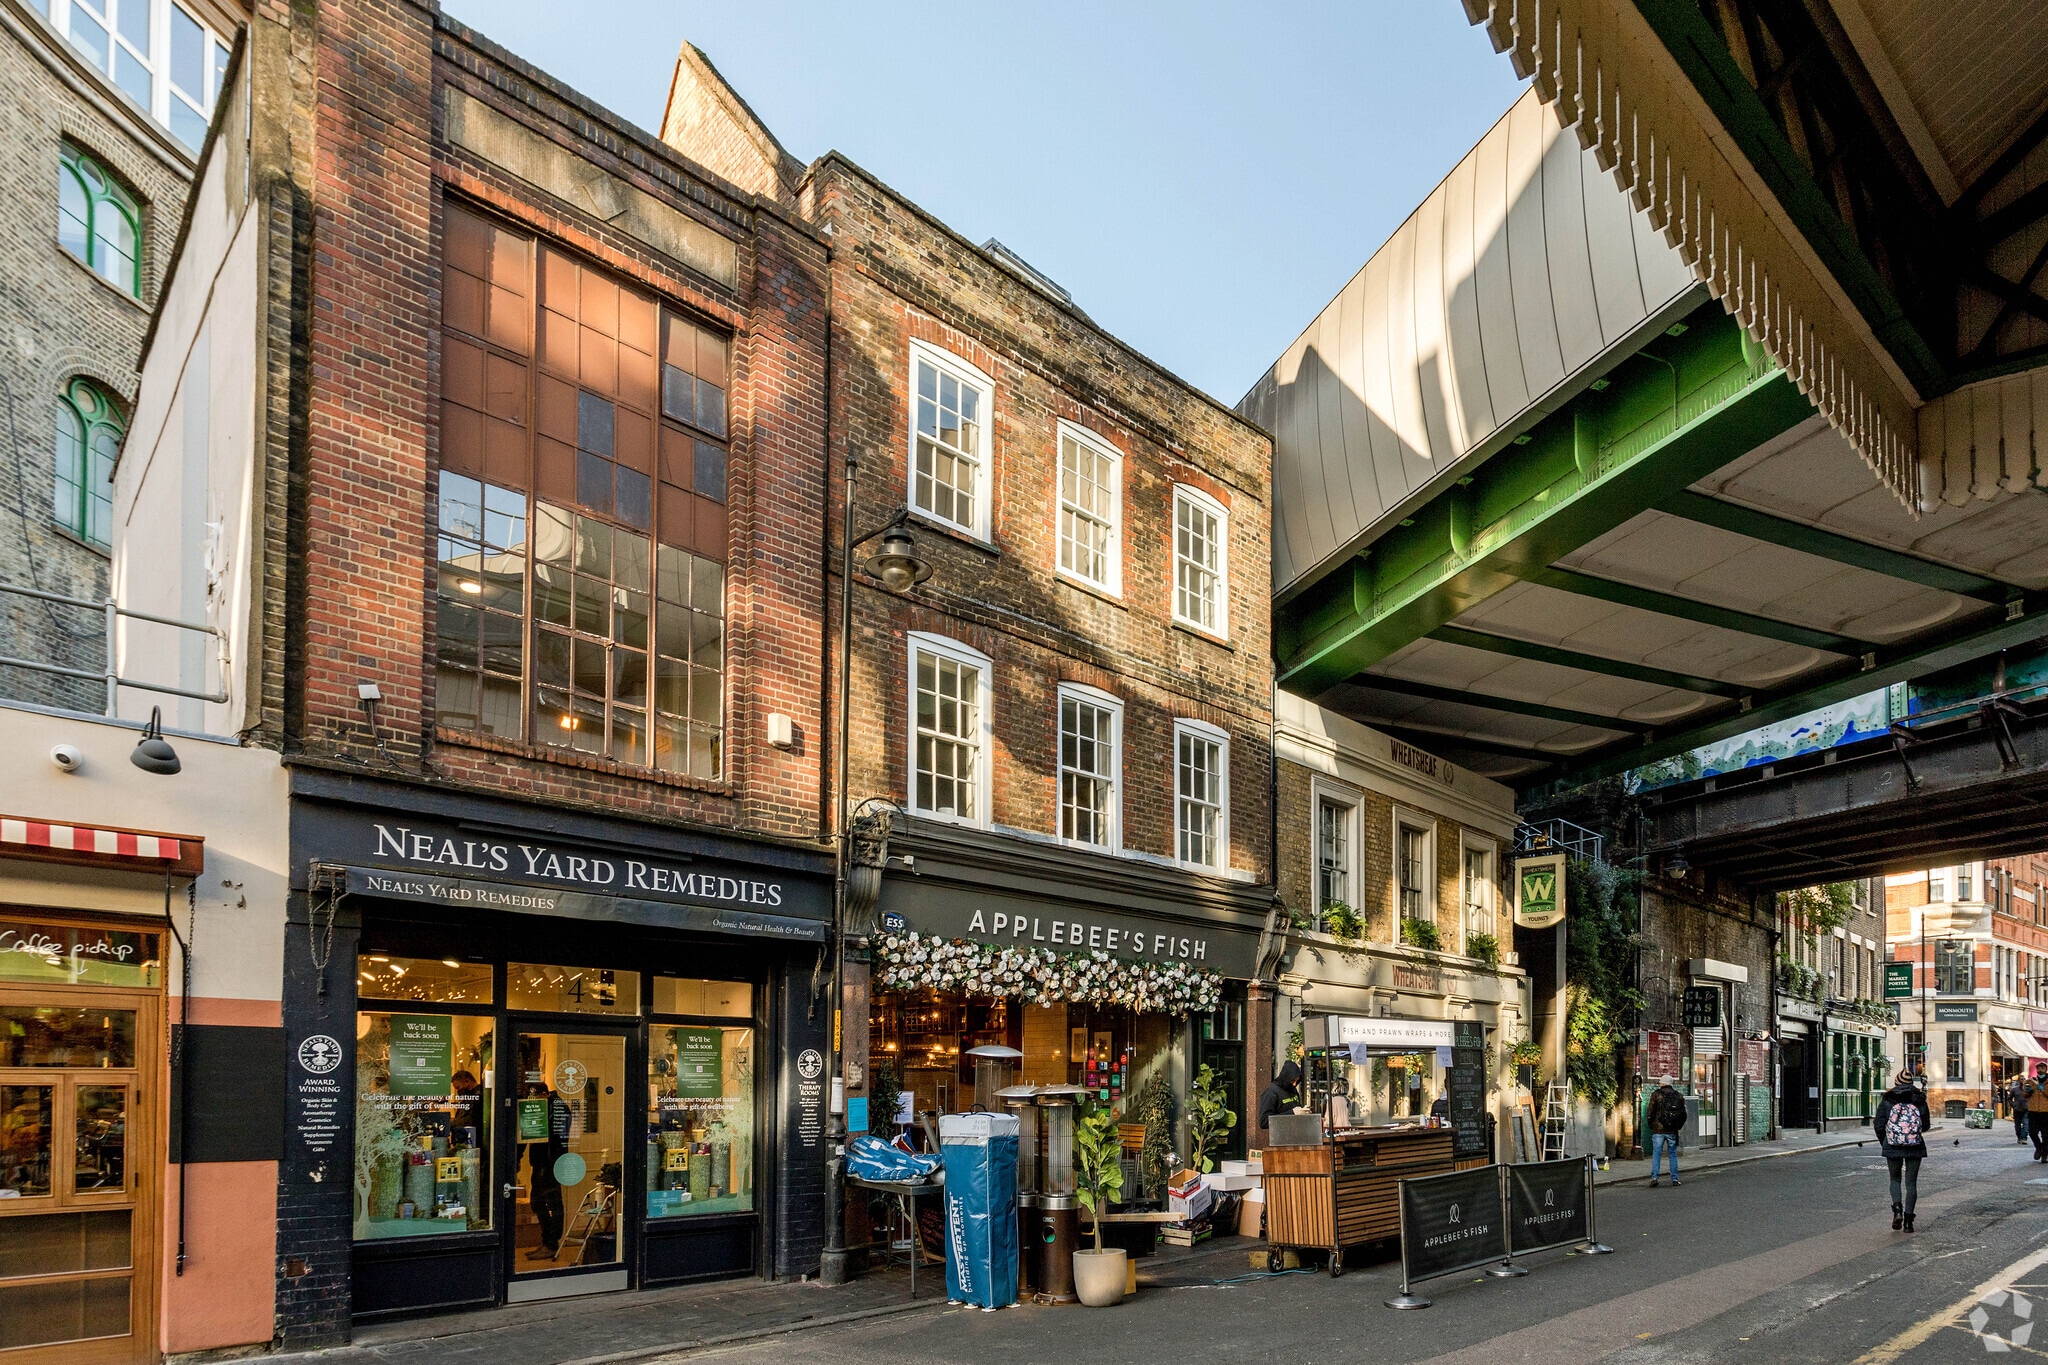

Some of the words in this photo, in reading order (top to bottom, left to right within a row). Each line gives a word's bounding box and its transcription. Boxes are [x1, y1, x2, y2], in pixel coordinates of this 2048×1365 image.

[1390, 739, 1437, 778] WHEATSHEAF
[373, 824, 508, 871] NEAL'S
[518, 845, 615, 884] YARD
[624, 860, 782, 906] REMEDIES
[367, 876, 424, 895] NEAL'S
[427, 884, 472, 900] YARD
[476, 889, 554, 910] REMEDIES
[712, 918, 737, 930] Organic
[739, 922, 763, 932] Natural
[764, 924, 784, 934] Health
[785, 926, 793, 934] &
[794, 927, 815, 938] Beauty
[886, 917, 904, 929] ESS
[968, 909, 1144, 953] APPLEBEE'S
[1153, 934, 1206, 960] FISH
[0, 930, 63, 959] Coffee
[1391, 964, 1440, 991] WHEATSHEAF
[567, 977, 586, 1004] 4
[1685, 1002, 1713, 1013] PAS
[403, 1031, 422, 1039] back
[406, 1023, 426, 1031] We'll
[427, 1023, 437, 1031] be
[1342, 1027, 1359, 1035] FISH
[1362, 1028, 1376, 1036] AND
[1379, 1028, 1402, 1036] PRAWN
[302, 1037, 323, 1053] NEAL'S
[325, 1037, 339, 1054] YARD
[303, 1057, 338, 1071] REMEDIES
[361, 1093, 400, 1101] Celebrate
[373, 1101, 392, 1110] with
[394, 1102, 407, 1110] the
[408, 1102, 422, 1111] gift
[424, 1102, 432, 1110] of
[433, 1102, 471, 1111] wellbeing
[689, 1103, 700, 1111] gift
[1561, 1209, 1576, 1219] FISH
[950, 1197, 968, 1293] MASTERTENT
[1424, 1229, 1468, 1249] APPLEBEE'S
[1470, 1225, 1488, 1237] FISH
[962, 1241, 967, 1252] up
[964, 1255, 973, 1293] building
